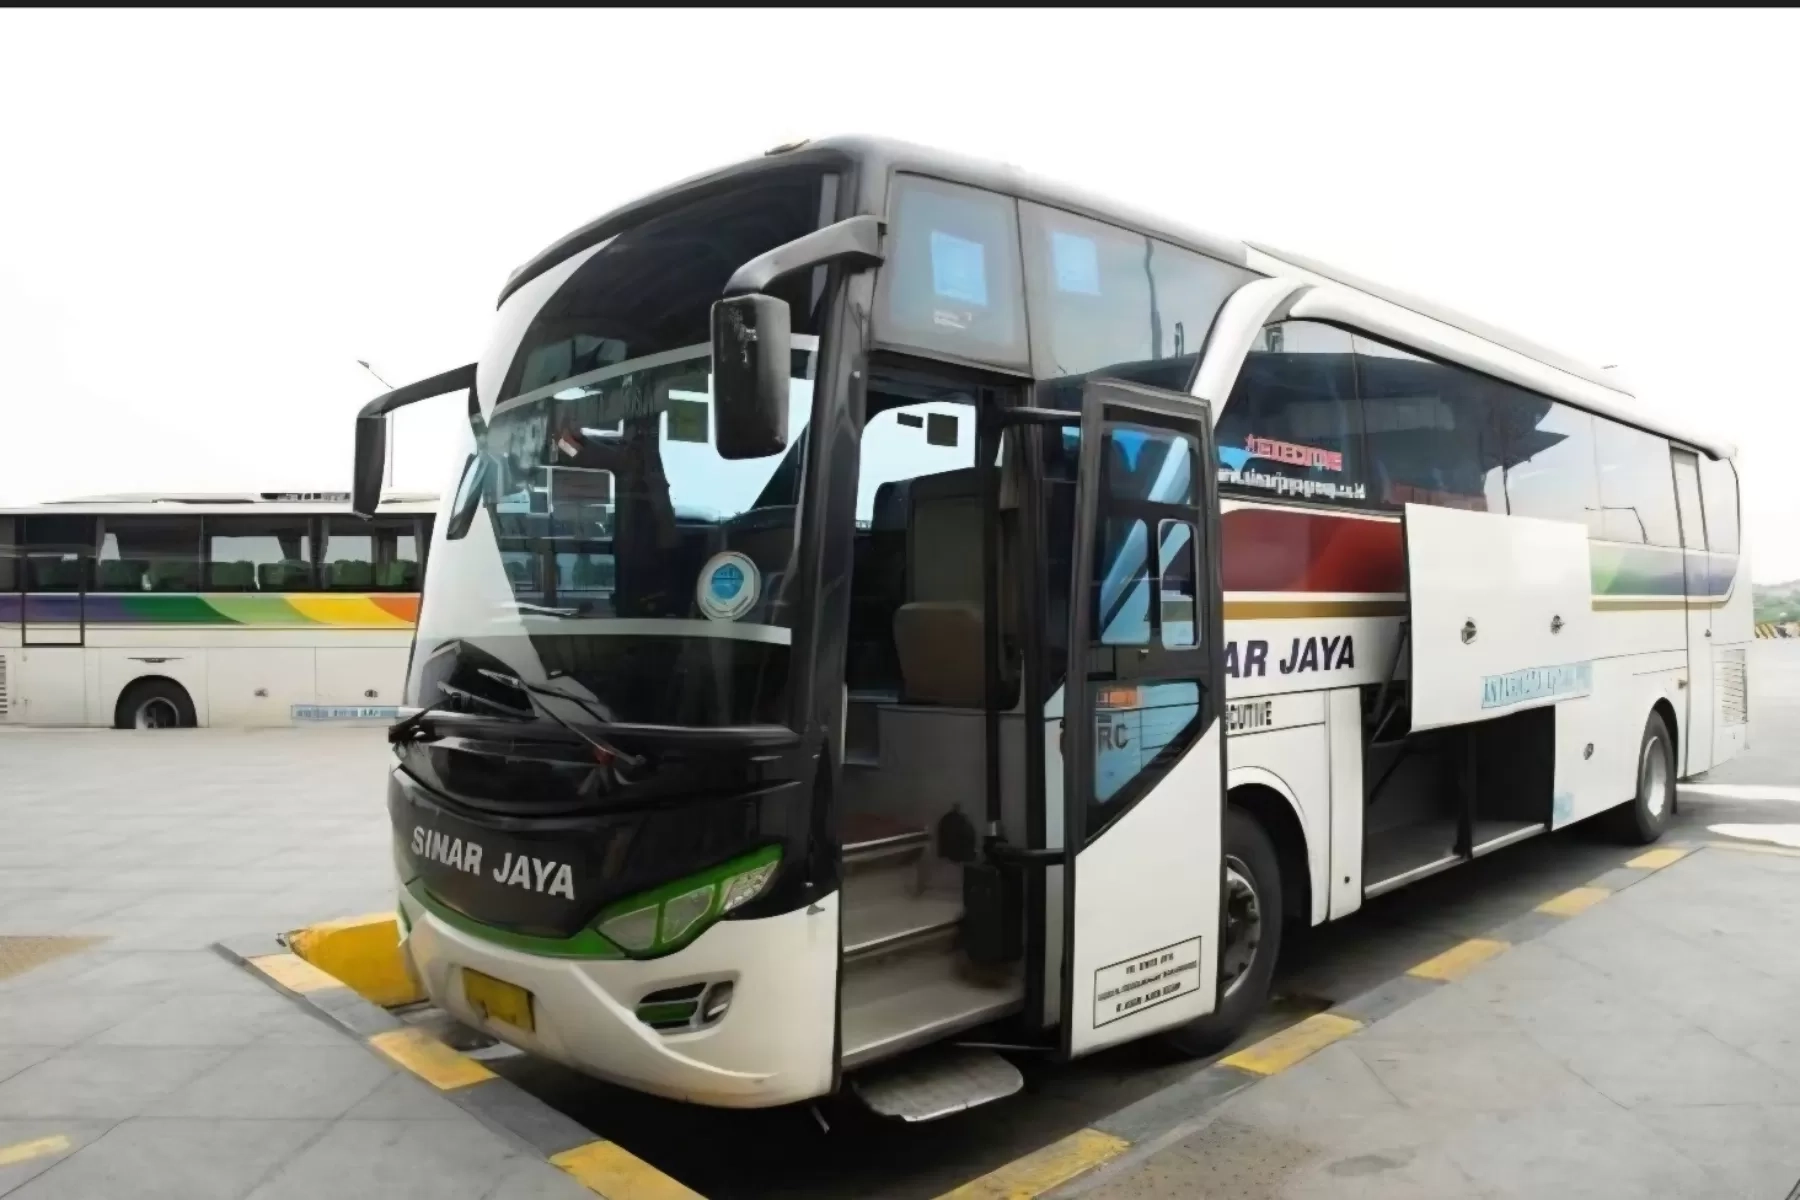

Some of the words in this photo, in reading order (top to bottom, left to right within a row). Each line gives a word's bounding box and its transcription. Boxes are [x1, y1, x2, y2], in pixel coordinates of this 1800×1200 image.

[1279, 635, 1355, 674] JAYA
[412, 826, 482, 876] SINAR
[493, 852, 575, 900] JAYA
